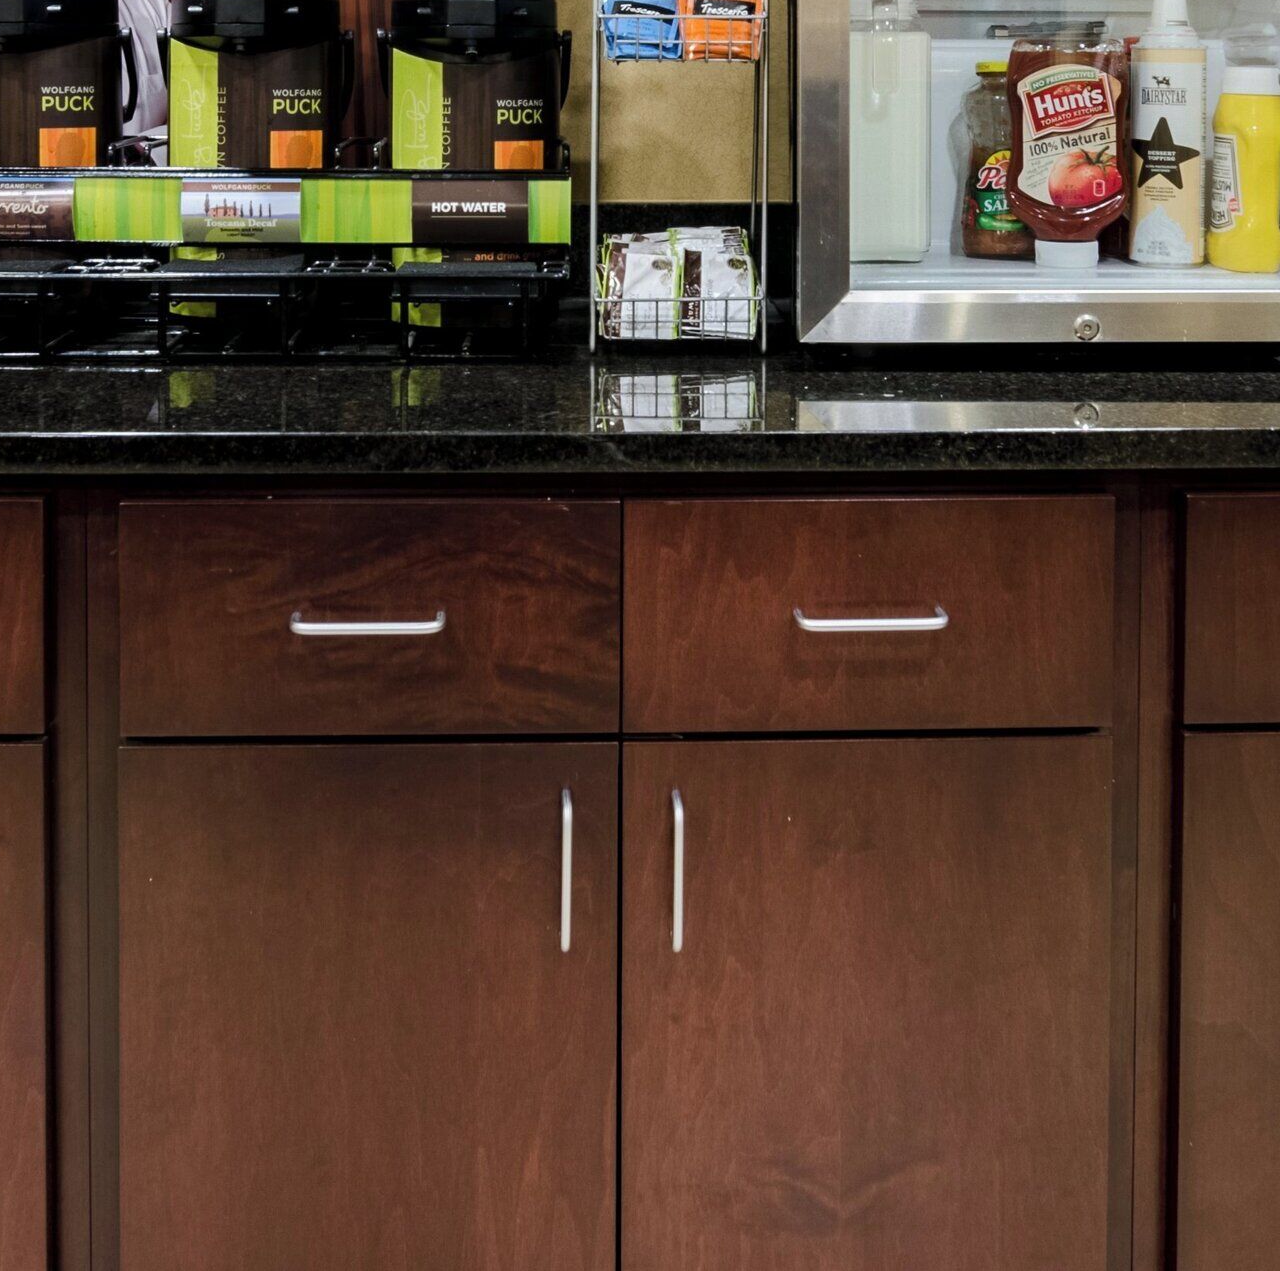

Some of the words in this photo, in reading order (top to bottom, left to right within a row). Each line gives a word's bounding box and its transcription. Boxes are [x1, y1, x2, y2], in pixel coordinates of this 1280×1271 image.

[41, 86, 95, 94] WOLFGANG
[272, 89, 322, 97] WOLFGANG
[1141, 88, 1187, 105] DAIRYSTAR
[41, 95, 94, 112] PUCK
[272, 98, 321, 115] PUCK
[496, 99, 544, 108] WOLFGANG
[1033, 86, 1105, 119] Hunt's
[217, 86, 227, 145] COFFEE
[496, 109, 543, 125] PUCK
[1040, 113, 1072, 127] TOMATO
[1073, 106, 1104, 118] KETCHUP
[442, 96, 451, 156] COFFEE
[1029, 142, 1059, 157] 100%
[1060, 127, 1111, 151] Natural
[431, 202, 459, 213] HOT
[461, 202, 506, 213] WATER
[983, 199, 1010, 213] SAL
[204, 218, 246, 227] Toscana
[248, 218, 278, 227] Decaf
[474, 252, 494, 261] and
